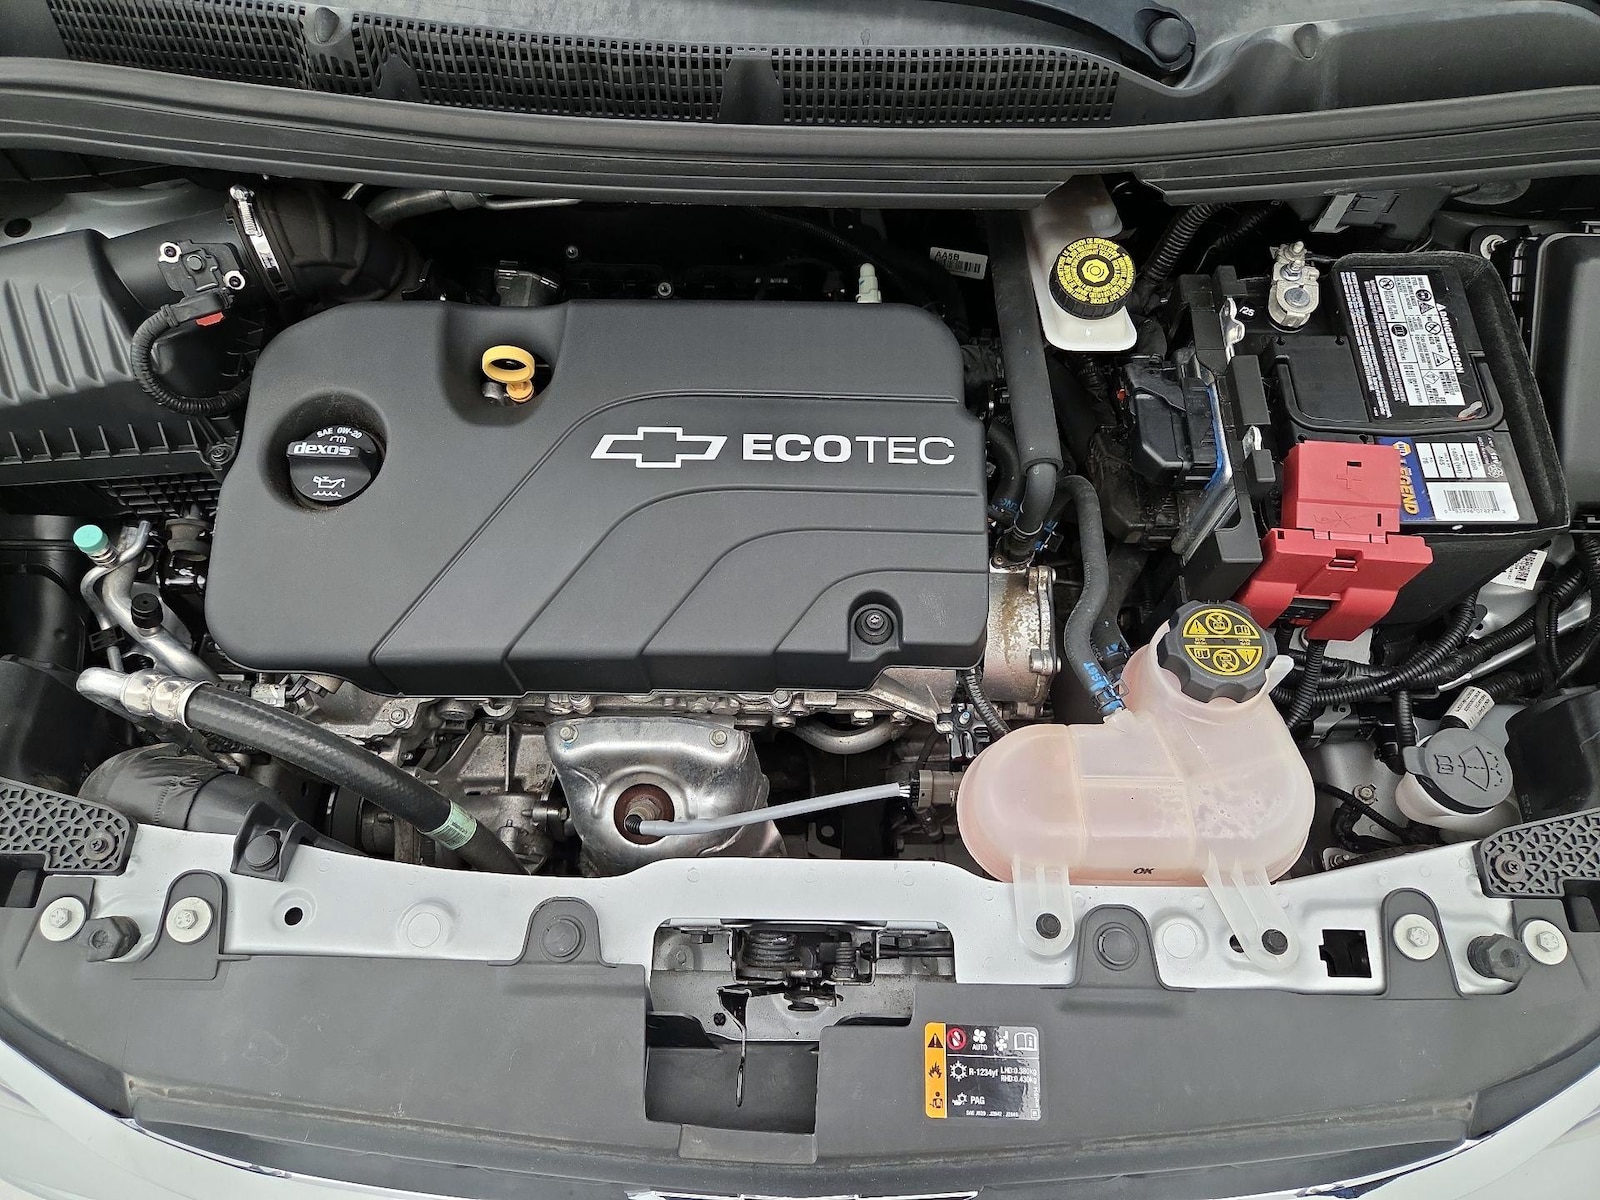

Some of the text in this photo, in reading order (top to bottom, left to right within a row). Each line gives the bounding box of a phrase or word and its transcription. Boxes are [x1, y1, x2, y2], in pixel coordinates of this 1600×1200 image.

[316, 426, 362, 439] SAE 0W-20
[293, 442, 354, 456] dexos
[742, 433, 955, 465] ECOTEC
[1133, 867, 1155, 875] OK
[968, 1067, 999, 1078] R-1234yf
[970, 1096, 985, 1105] PAG
